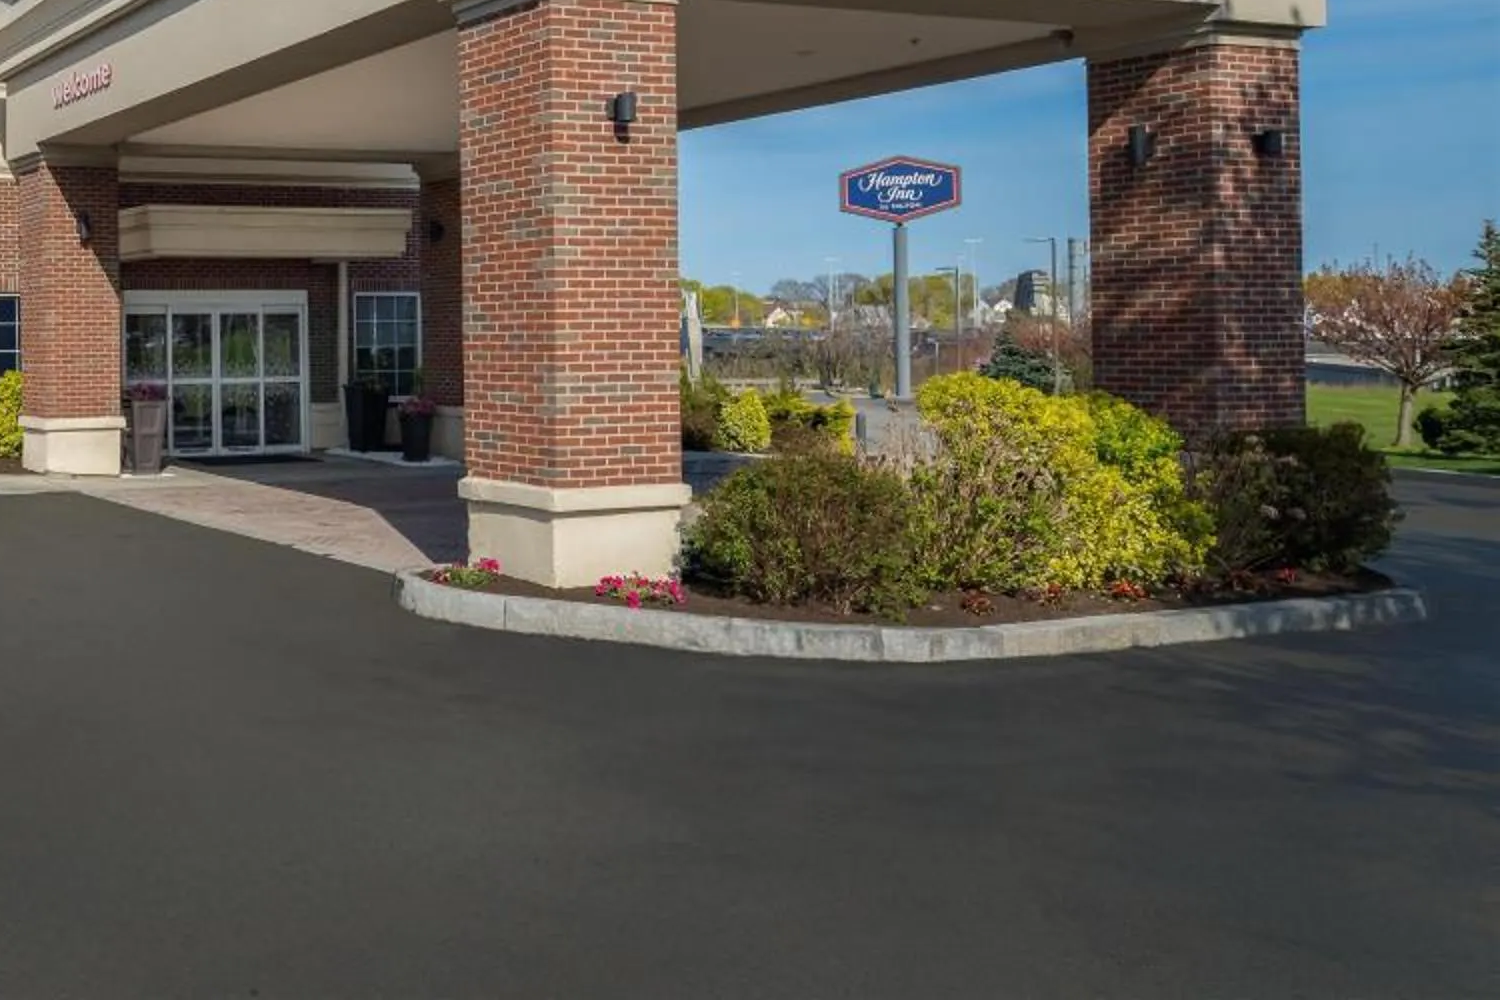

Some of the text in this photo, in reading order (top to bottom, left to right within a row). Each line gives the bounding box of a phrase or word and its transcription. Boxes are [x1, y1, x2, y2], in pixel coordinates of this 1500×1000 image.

[52, 64, 112, 109] welcome
[858, 171, 942, 192] Hampton
[878, 187, 923, 202] Inn
